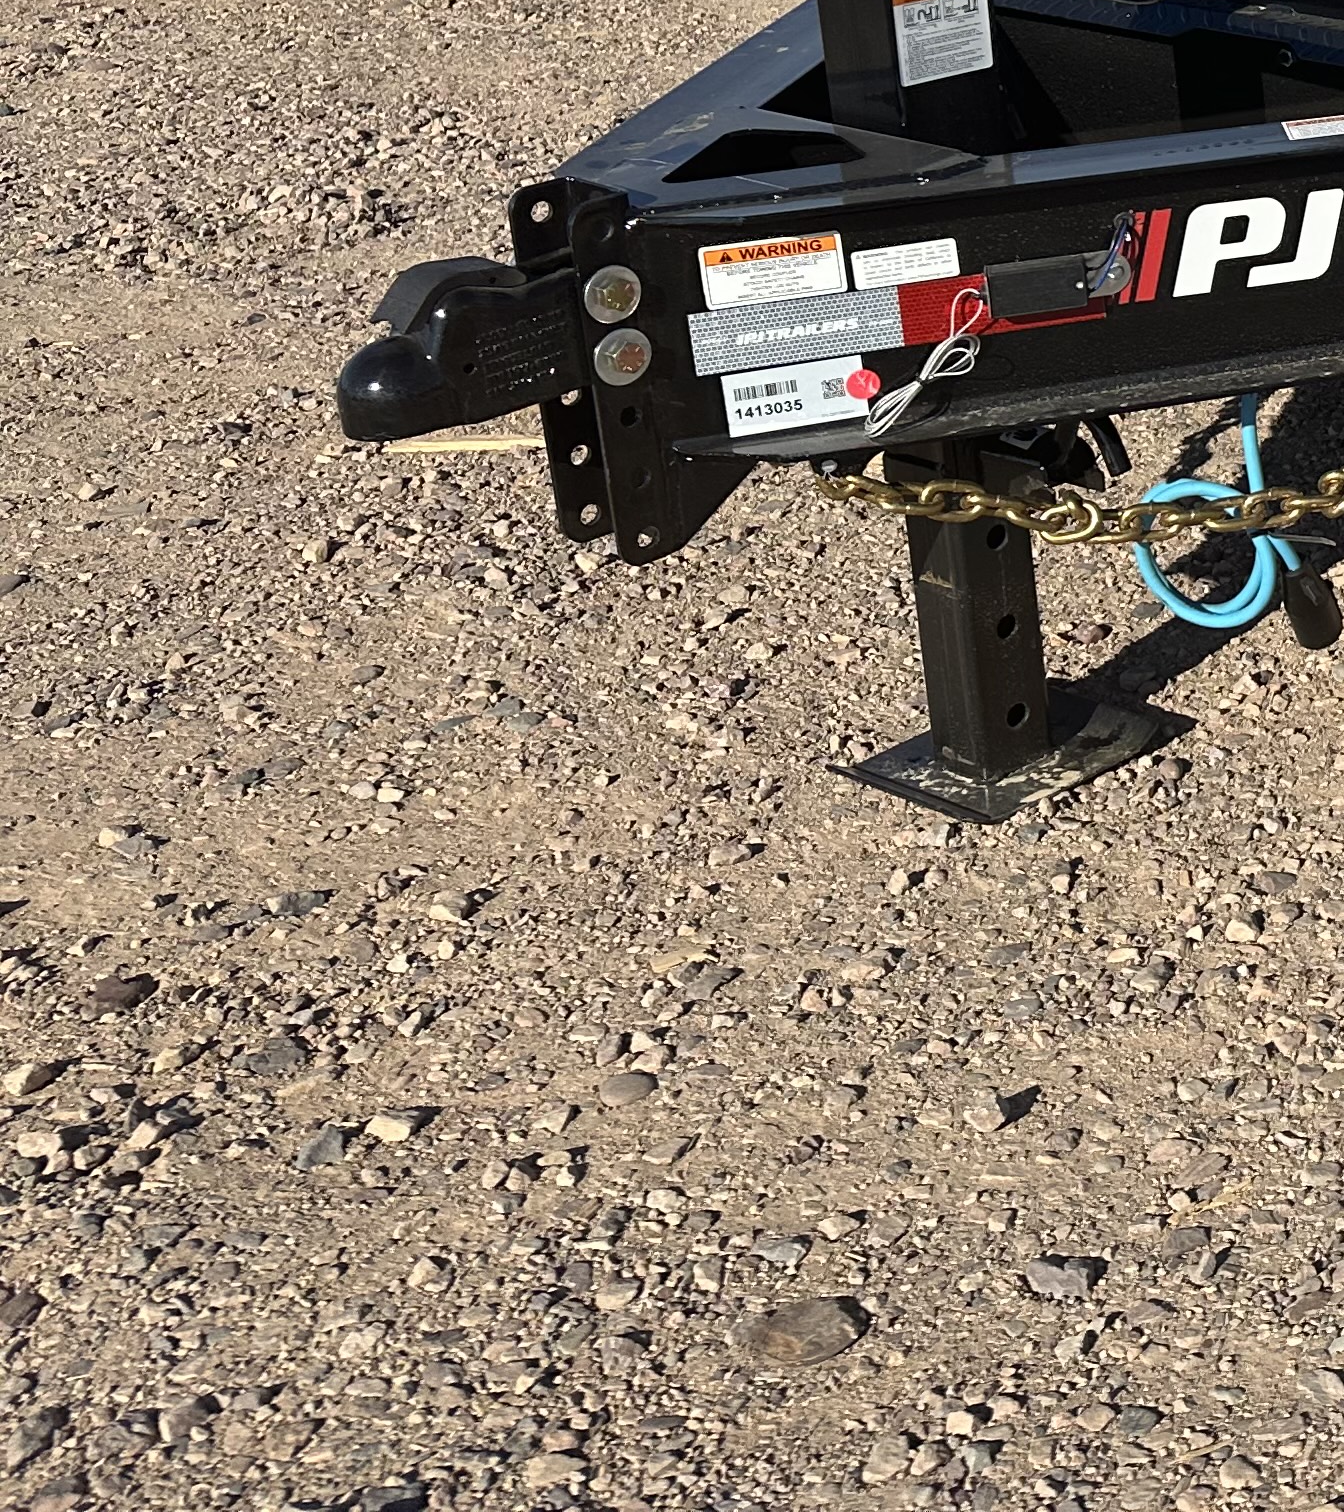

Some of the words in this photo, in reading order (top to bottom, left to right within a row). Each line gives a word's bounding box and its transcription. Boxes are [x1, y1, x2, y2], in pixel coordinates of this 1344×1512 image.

[739, 239, 821, 260] WARNING
[1172, 188, 1344, 297] PJ
[766, 317, 859, 341] TRAILERS
[735, 399, 803, 419] 1413035
